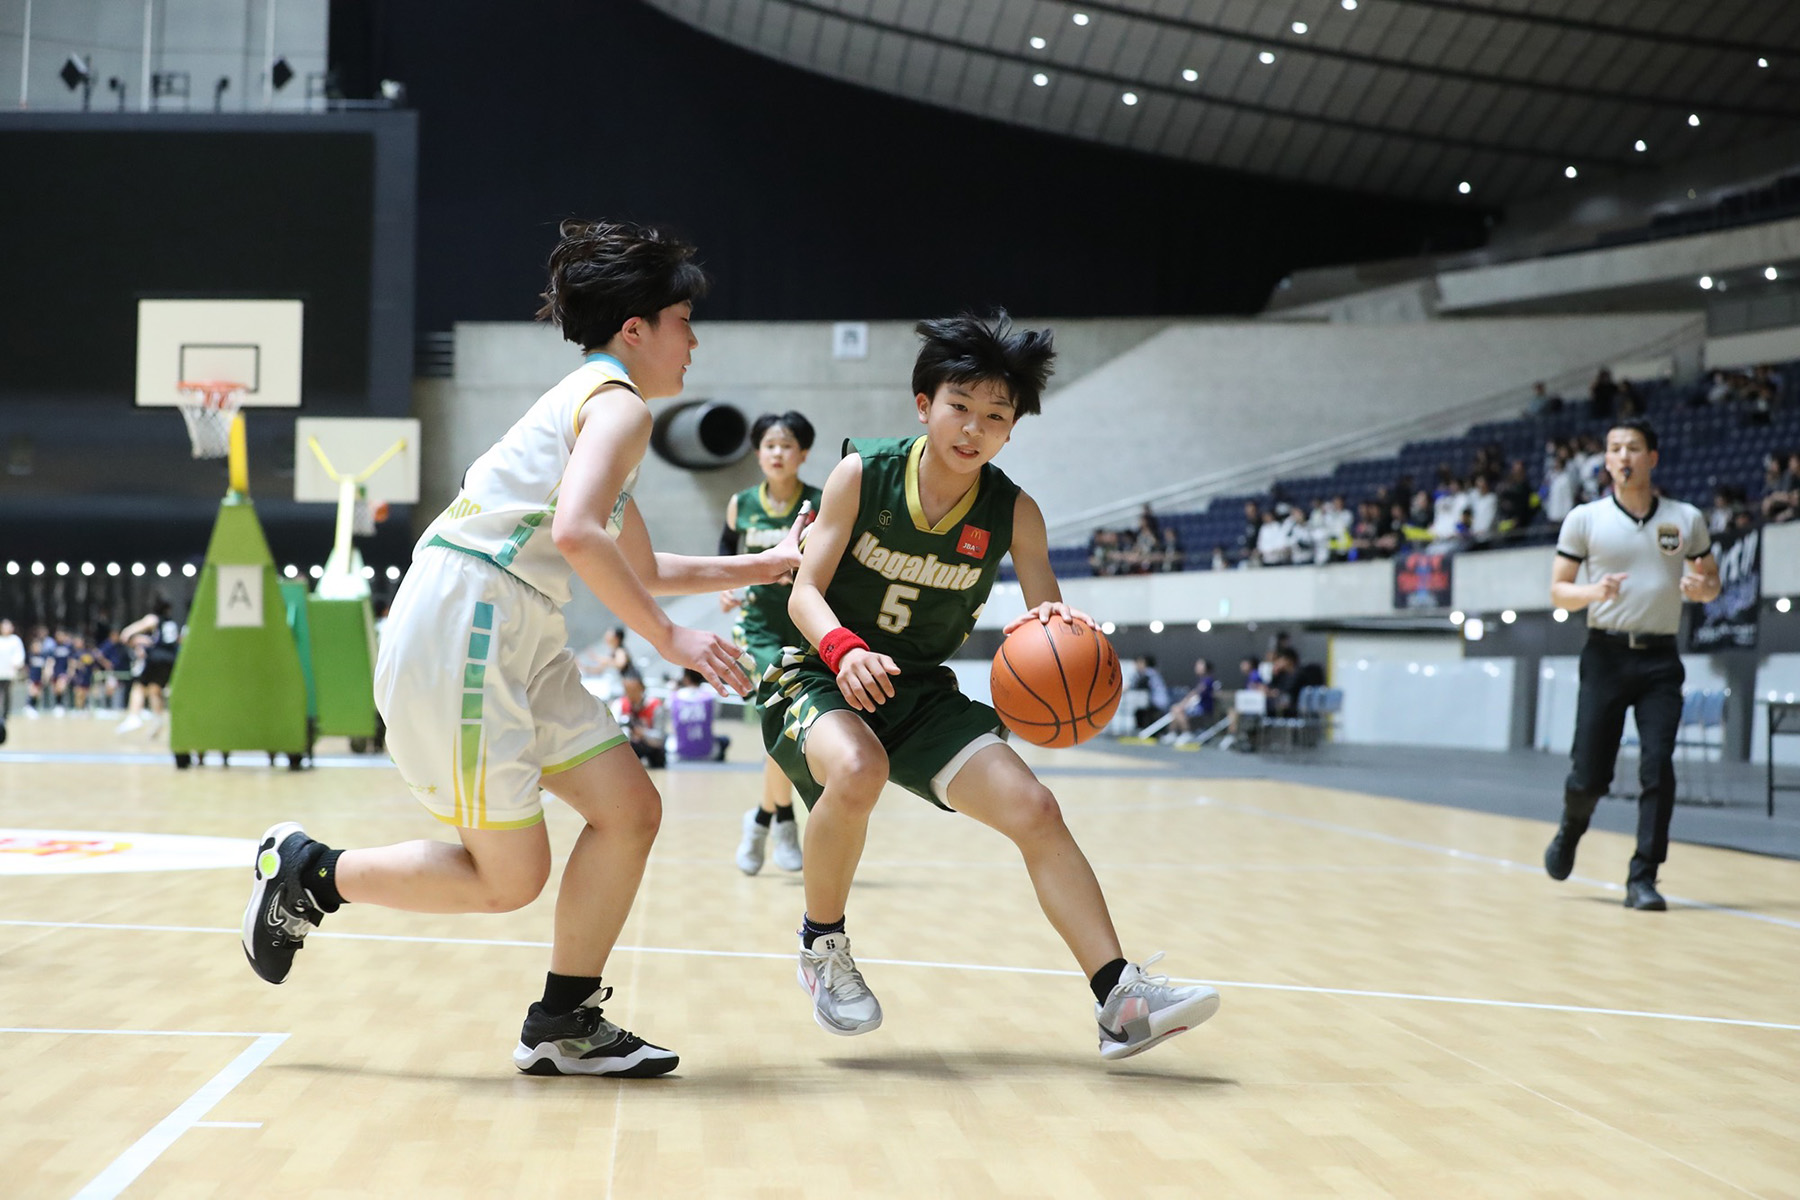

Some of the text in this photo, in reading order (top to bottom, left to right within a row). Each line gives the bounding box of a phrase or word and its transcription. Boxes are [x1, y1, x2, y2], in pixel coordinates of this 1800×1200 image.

[852, 531, 982, 590] Nagakute
[227, 579, 252, 609] A
[876, 584, 920, 634] 5
